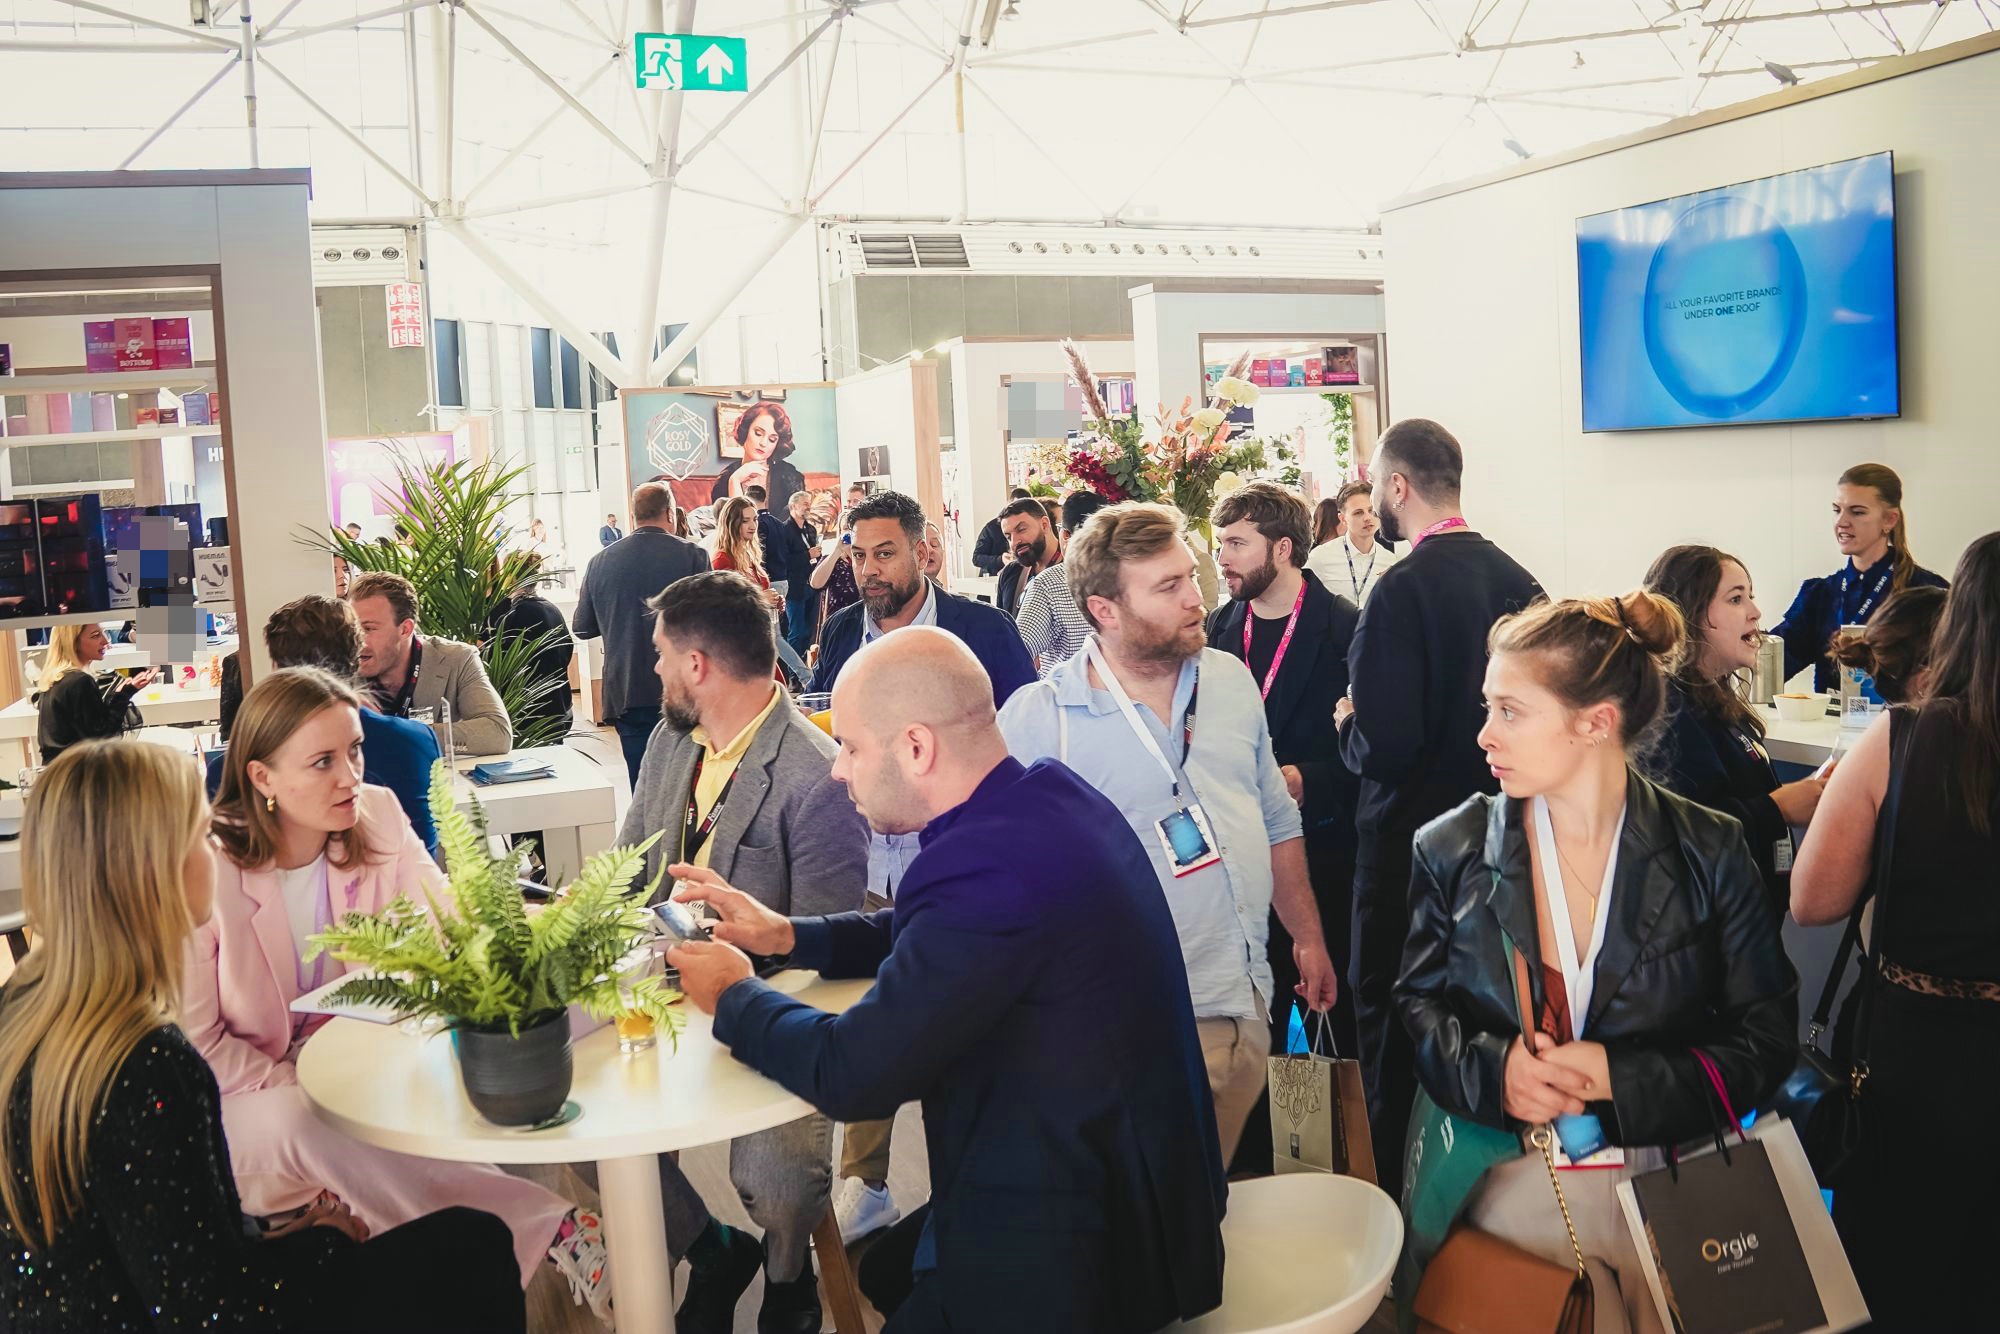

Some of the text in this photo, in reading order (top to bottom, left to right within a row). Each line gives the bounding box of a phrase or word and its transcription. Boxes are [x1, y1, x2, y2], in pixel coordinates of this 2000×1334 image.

[1679, 297, 1702, 308] YOUR
[1703, 291, 1745, 305] FAVORITE
[1684, 302, 1761, 320] UNDER ONE ROOF
[664, 430, 691, 442] ROSY
[665, 441, 692, 451] GOLD
[1701, 1231, 1759, 1262] Orgie
